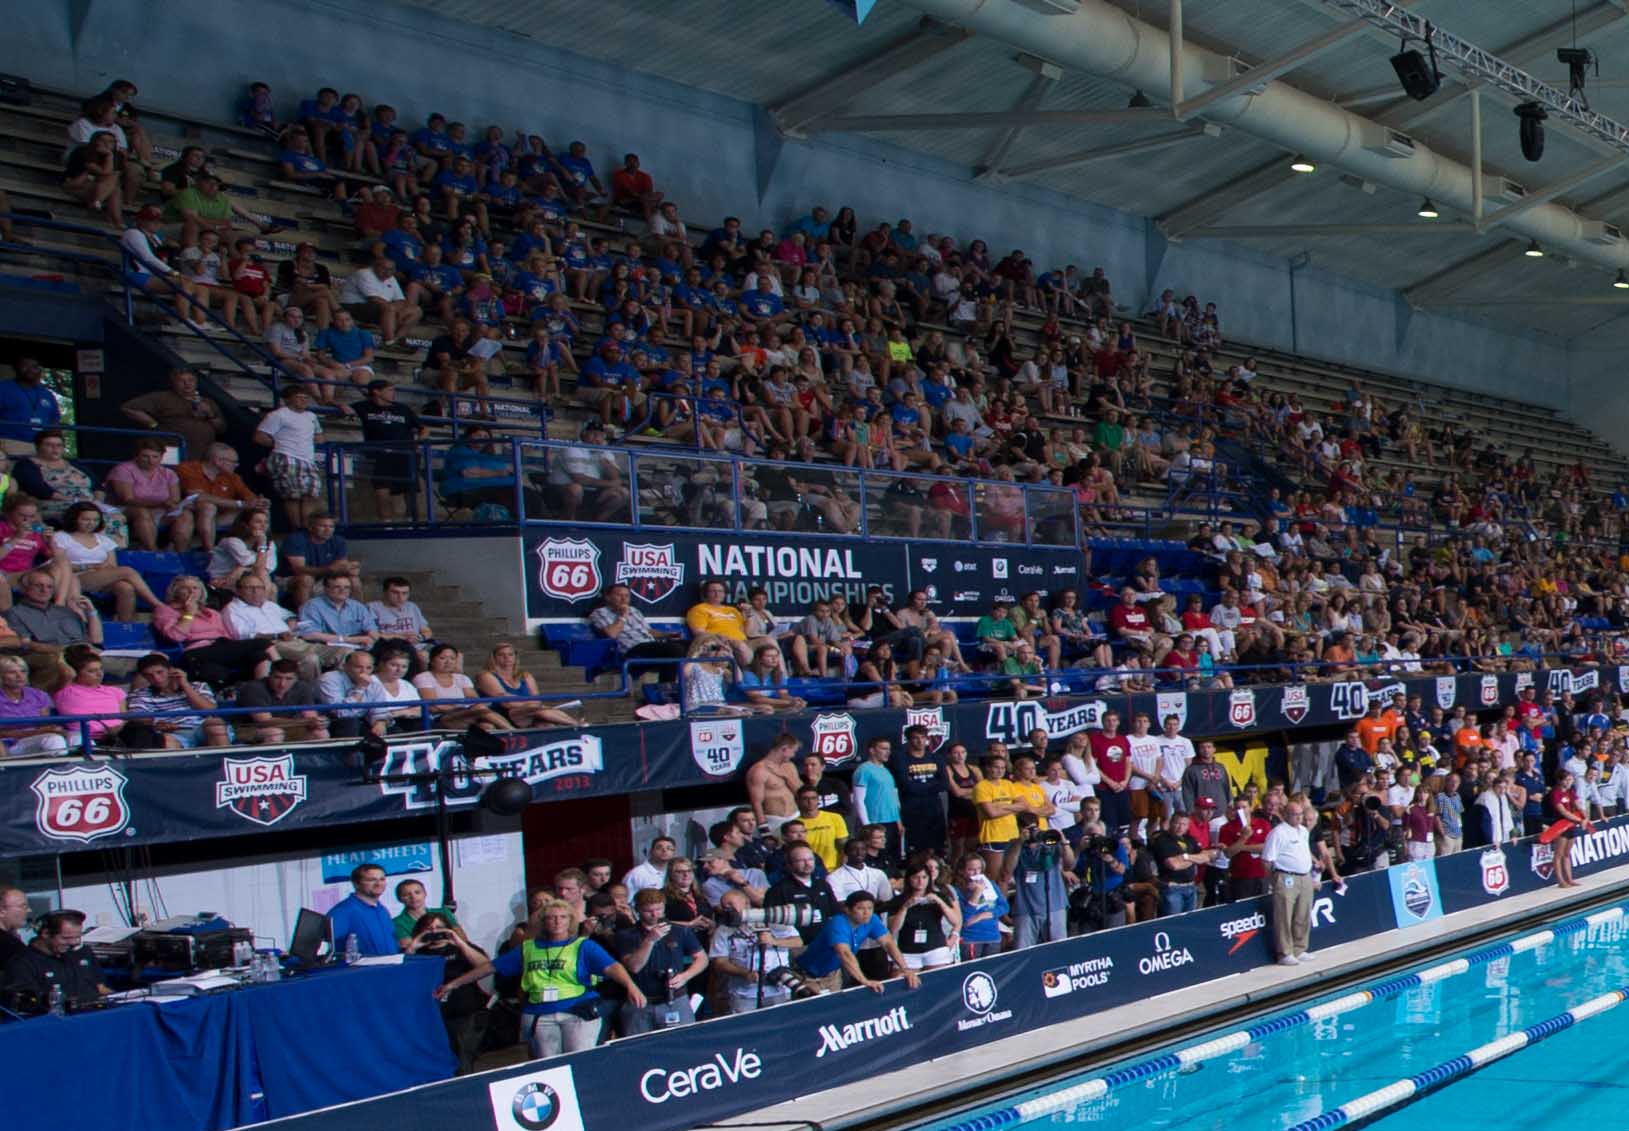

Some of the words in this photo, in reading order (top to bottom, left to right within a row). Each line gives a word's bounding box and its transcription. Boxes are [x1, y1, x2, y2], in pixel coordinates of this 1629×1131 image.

[547, 547, 592, 562] PHILLIPS
[630, 548, 669, 567] USA
[699, 543, 863, 579] NATIONAL
[552, 563, 591, 589] 66
[621, 565, 678, 579] SWIMMING
[1549, 669, 1572, 699] 40
[1331, 681, 1367, 719] 40
[911, 712, 938, 728] USA
[1232, 703, 1253, 720] 66
[818, 720, 850, 733] PHILLIPS
[985, 700, 1043, 749] 40
[1046, 709, 1098, 736] YEARS
[706, 746, 730, 763] 40
[822, 735, 849, 754] 66
[489, 744, 583, 779] YEARS
[234, 763, 287, 784] USA
[554, 775, 592, 792] 2013
[47, 775, 114, 794] PHILLIPS
[223, 780, 299, 798] SWIMMING
[55, 796, 112, 827] 66
[371, 844, 428, 861] SHEETS
[1487, 866, 1504, 888] 66
[1220, 911, 1266, 939] speedo
[1069, 956, 1114, 977] MYRTHA
[1139, 948, 1194, 976] OMEGA
[1072, 973, 1109, 991] POOLS
[816, 1006, 912, 1058] Marriott
[640, 1049, 762, 1105] CeraVe
[514, 1082, 555, 1103] BMW
